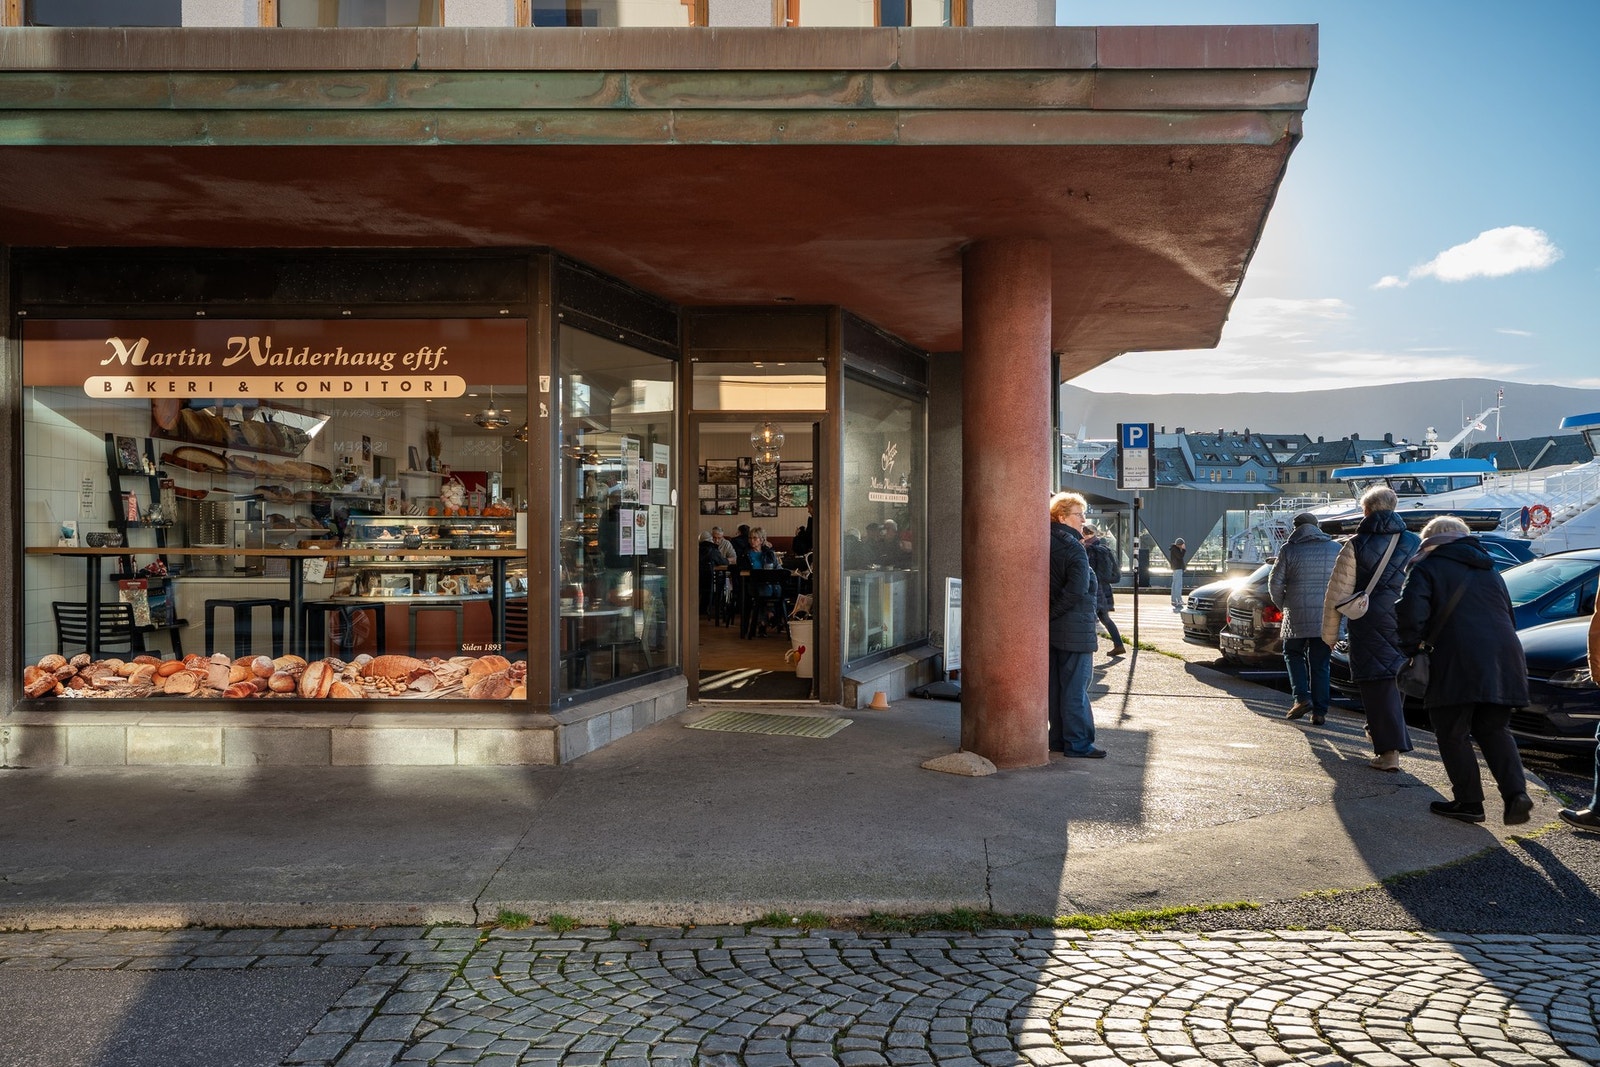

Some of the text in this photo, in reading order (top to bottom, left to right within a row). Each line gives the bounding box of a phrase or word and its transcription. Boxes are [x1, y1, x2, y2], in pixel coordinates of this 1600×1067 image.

[100, 335, 449, 371] Martin Walderhaug eftf.
[103, 380, 448, 393] BAKERI & KONDITORI
[1129, 426, 1143, 446] P
[461, 643, 502, 651] Siden 1893
